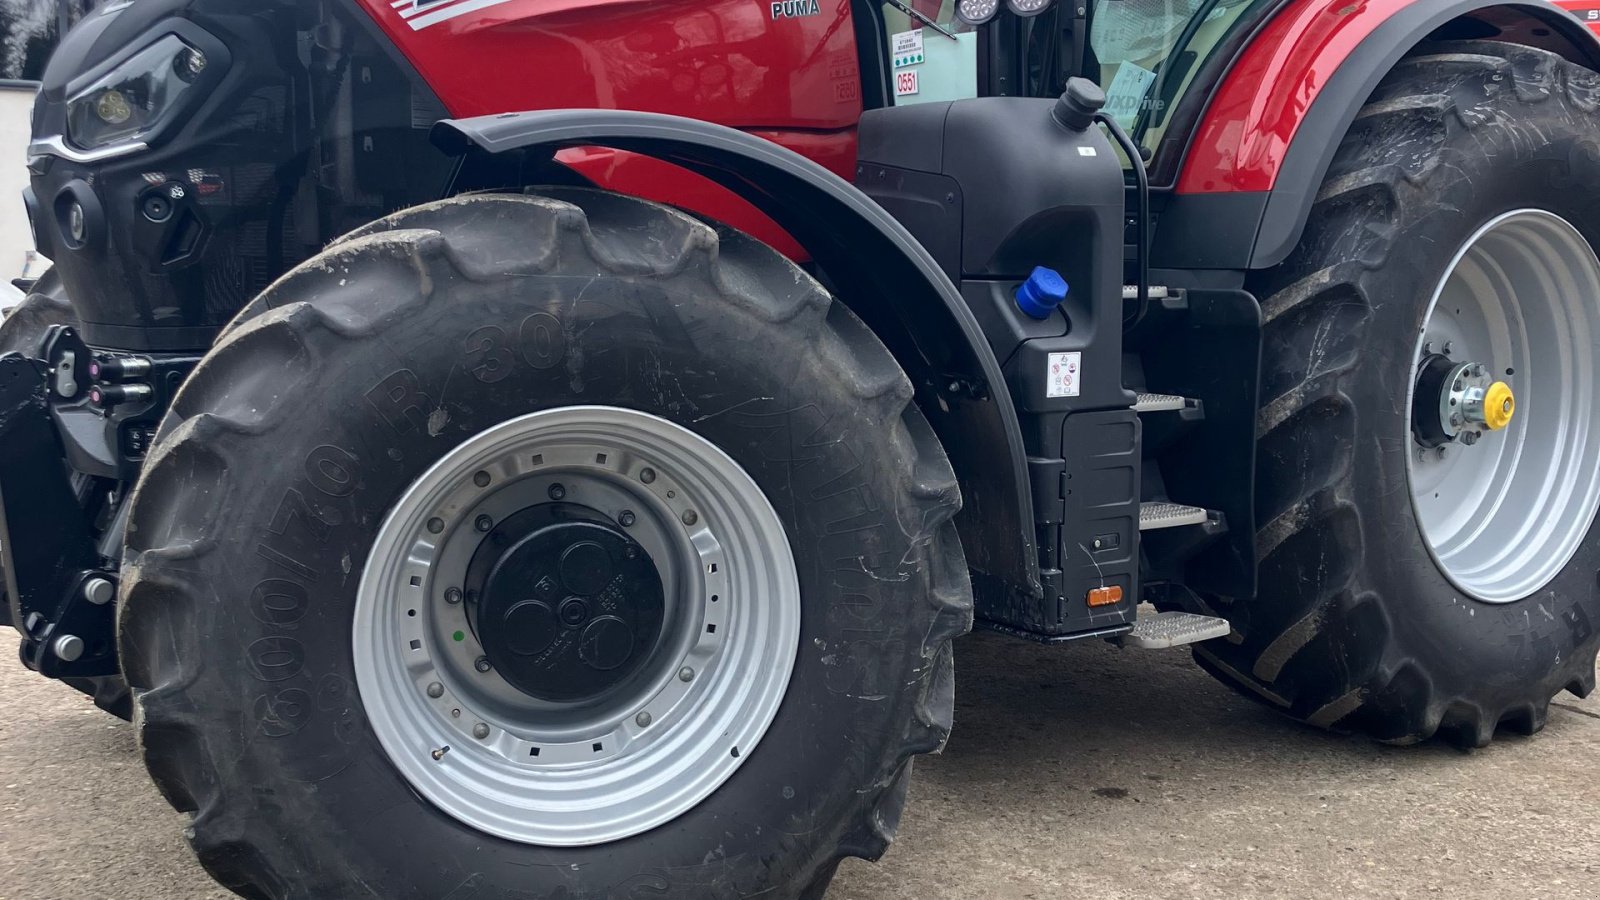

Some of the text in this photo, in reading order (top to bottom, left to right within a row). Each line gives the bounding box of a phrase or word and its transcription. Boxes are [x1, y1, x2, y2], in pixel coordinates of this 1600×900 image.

[771, 0, 821, 20] PUMA
[1588, 9, 1600, 20] S
[897, 73, 916, 92] 0551
[1105, 95, 1165, 110] VXDrive
[246, 312, 566, 738] 600/70 R 30
